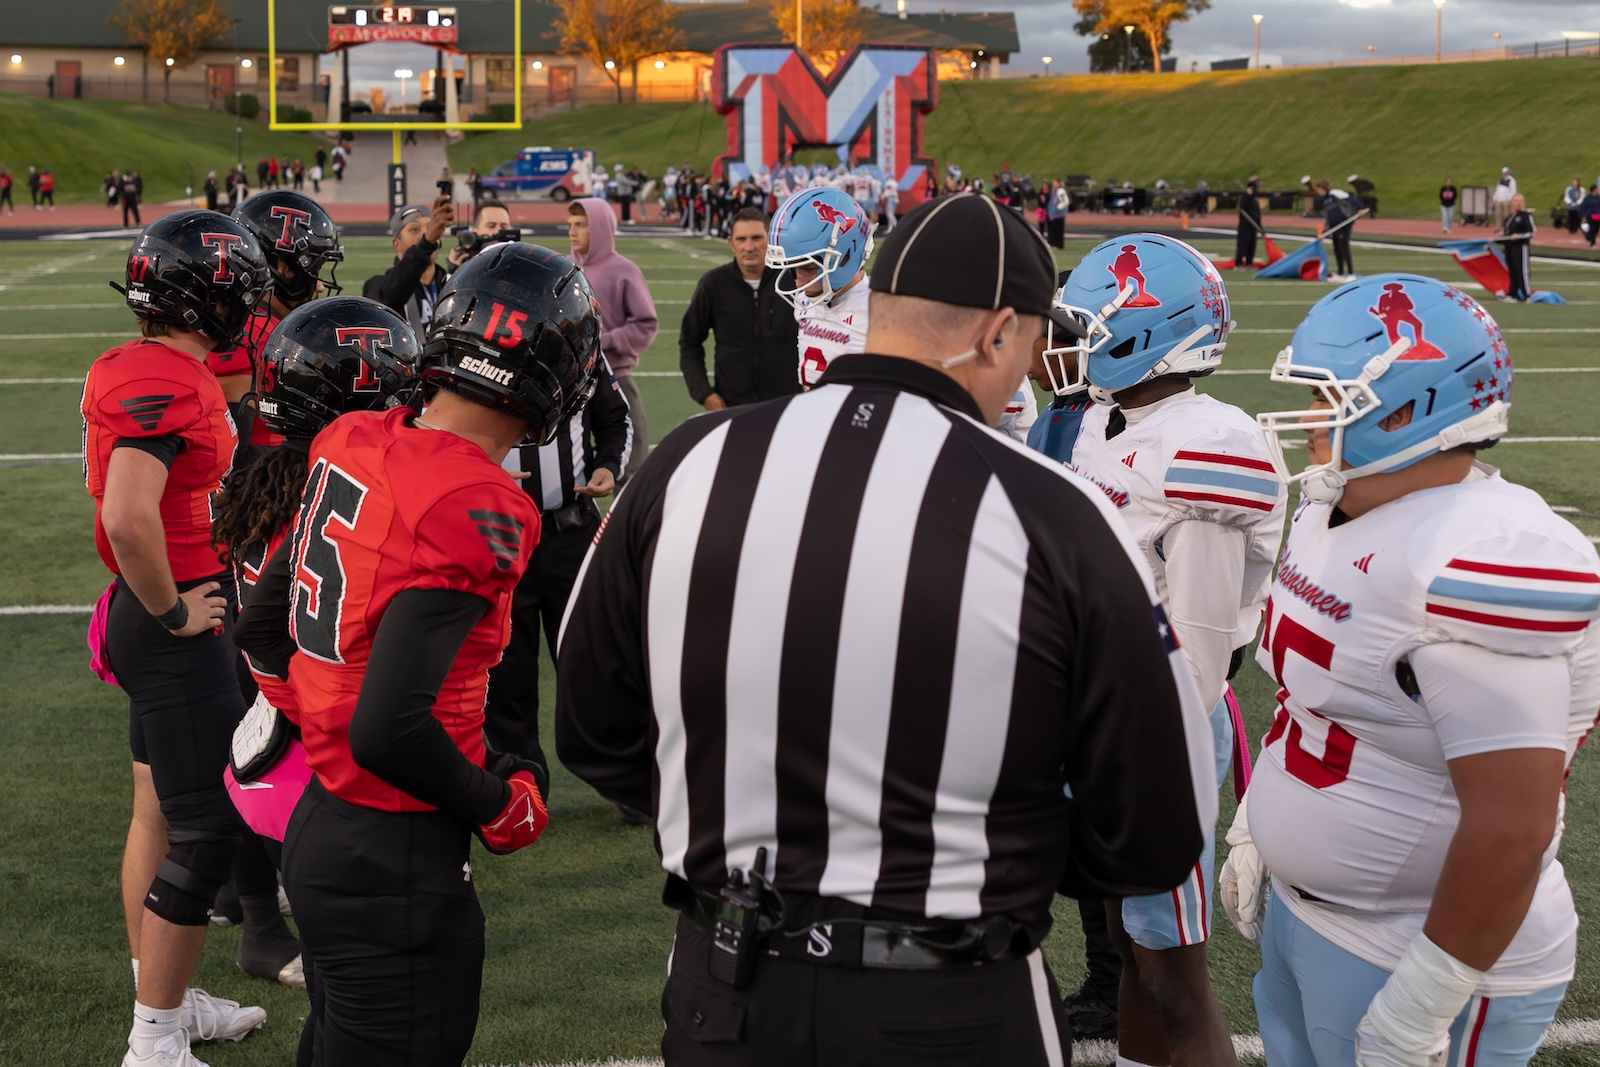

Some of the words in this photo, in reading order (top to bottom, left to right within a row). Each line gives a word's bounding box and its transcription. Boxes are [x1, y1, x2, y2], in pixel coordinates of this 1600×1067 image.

[393, 166, 404, 214] AIS
[269, 206, 312, 253] T
[129, 255, 151, 282] 37
[200, 233, 244, 284] T
[483, 302, 529, 348] 15
[798, 318, 851, 344] Plainsmen
[335, 326, 393, 392] T
[459, 355, 514, 386] schutt
